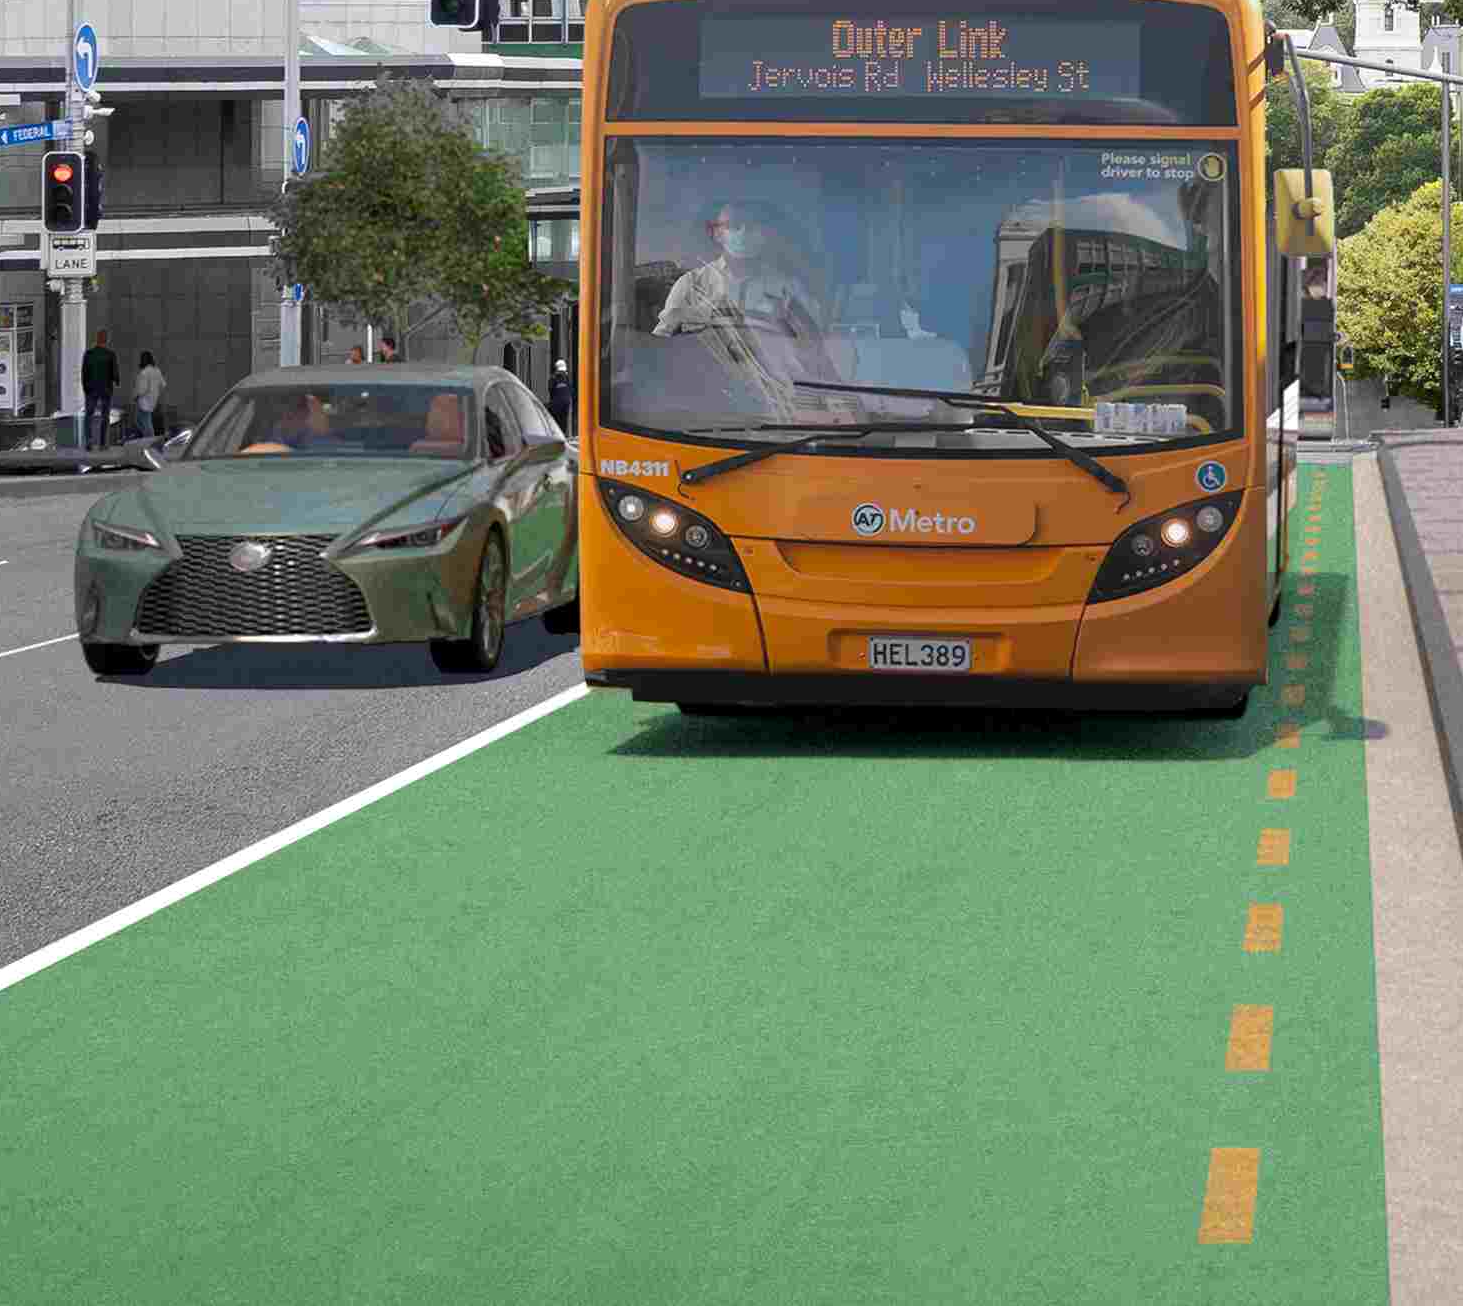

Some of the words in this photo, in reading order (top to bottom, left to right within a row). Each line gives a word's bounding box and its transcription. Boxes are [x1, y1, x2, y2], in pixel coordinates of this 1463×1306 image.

[832, 20, 922, 58] Outer
[937, 20, 1006, 58] Link
[748, 61, 855, 91] Jervois
[865, 61, 899, 91] Rd
[926, 61, 1050, 92] Wellesley
[1057, 61, 1090, 92] St
[12, 125, 51, 141] FEDERAL
[1100, 152, 1146, 165] Please
[1150, 152, 1192, 168] signal
[1100, 165, 1144, 178] driver
[1145, 167, 1161, 178] to
[1163, 168, 1193, 181] stop
[55, 258, 89, 269] LANE
[888, 507, 976, 533] Metro
[872, 644, 968, 667] HEL389
